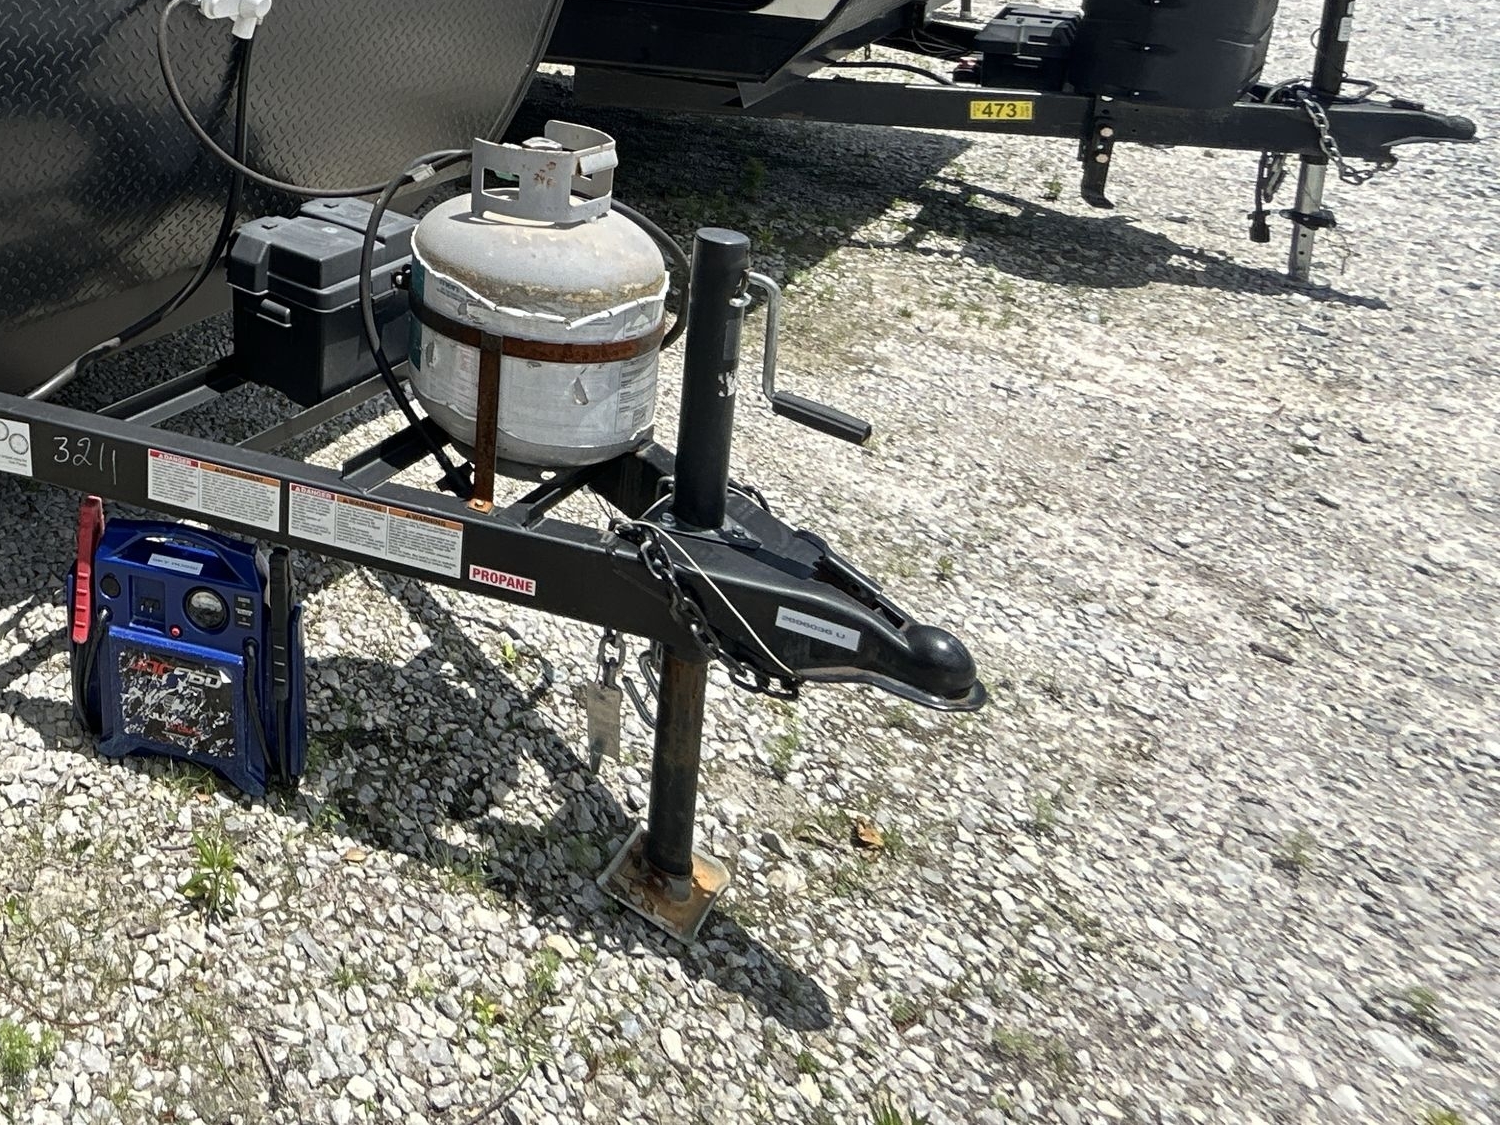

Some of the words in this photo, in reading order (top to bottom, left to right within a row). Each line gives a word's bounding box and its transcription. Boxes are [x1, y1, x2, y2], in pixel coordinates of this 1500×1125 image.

[981, 102, 1017, 118] 473
[53, 437, 117, 485] 3211
[165, 454, 191, 466] DANGER
[301, 487, 332, 500] DANGER
[412, 513, 446, 528] WARNING
[472, 567, 534, 593] PROPANE
